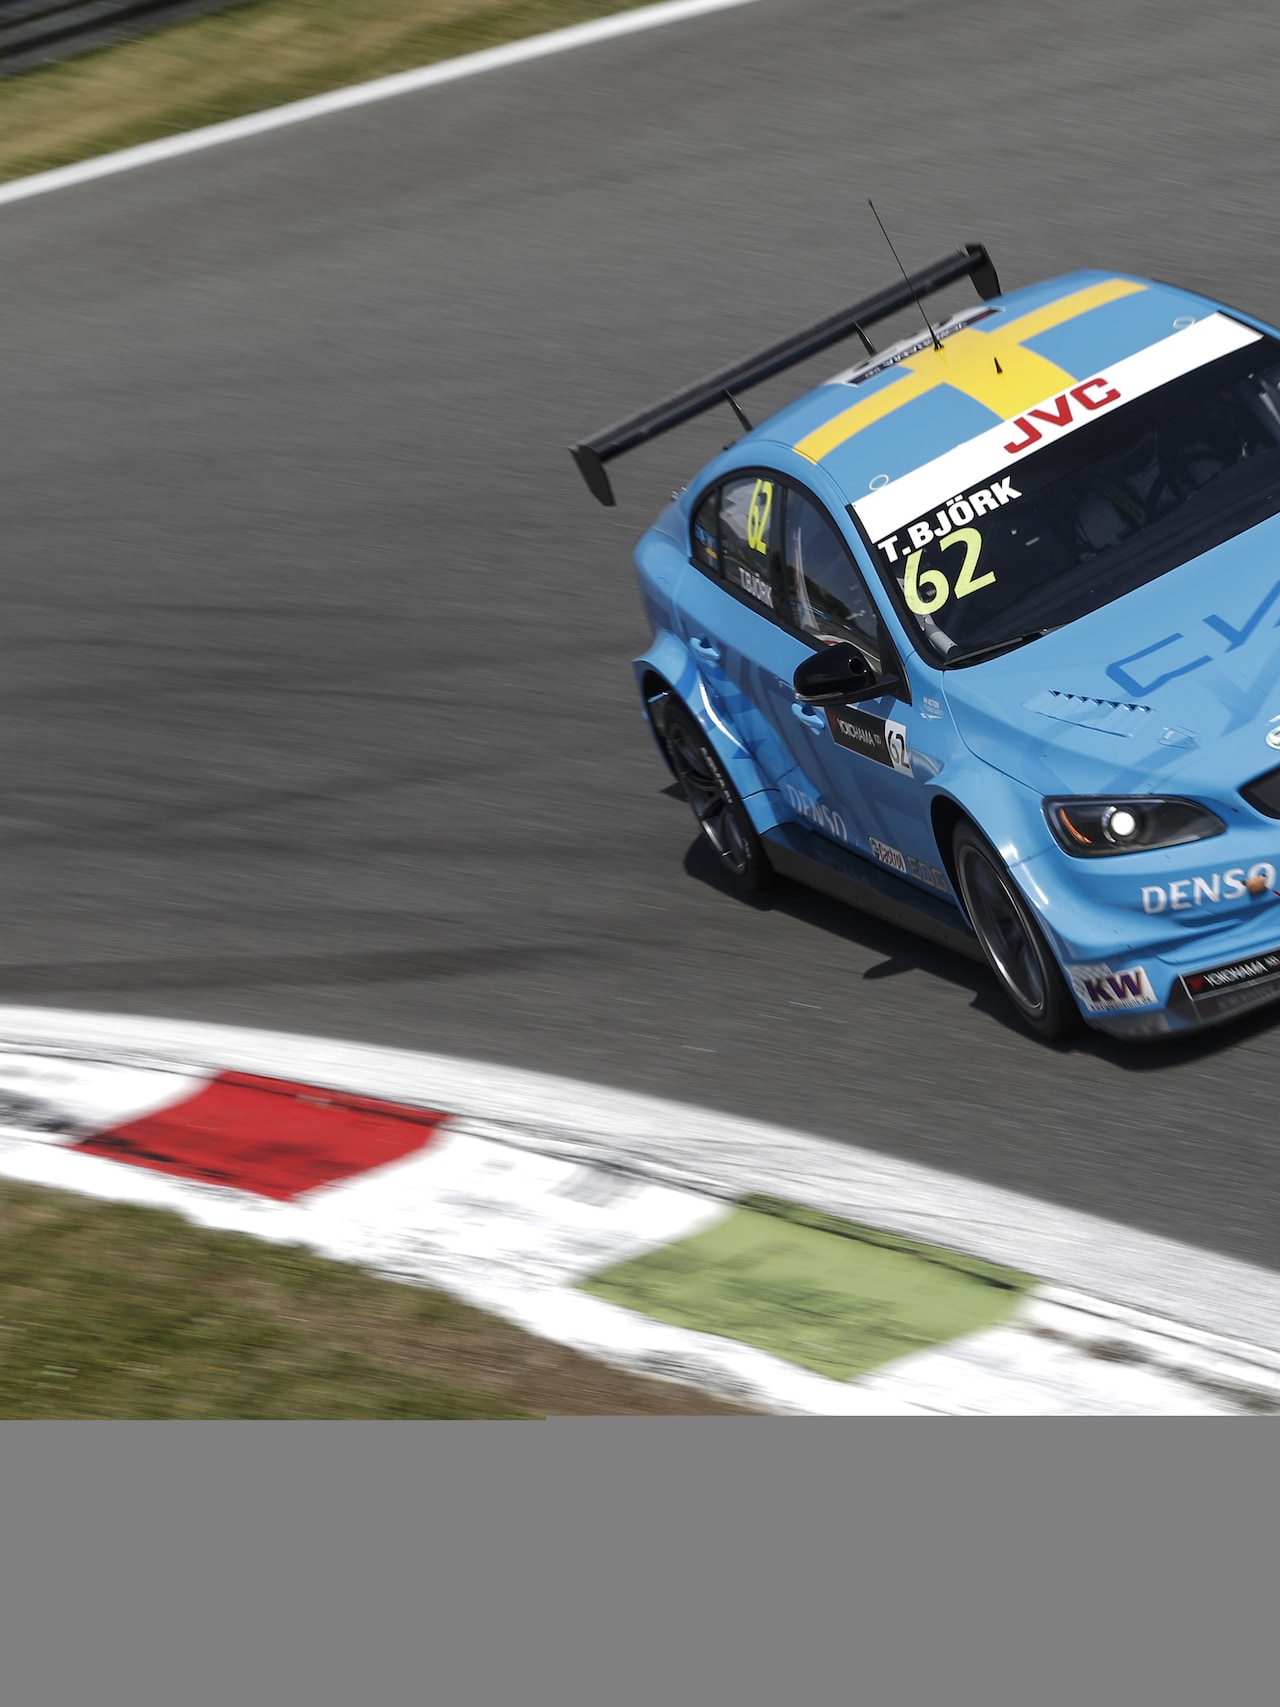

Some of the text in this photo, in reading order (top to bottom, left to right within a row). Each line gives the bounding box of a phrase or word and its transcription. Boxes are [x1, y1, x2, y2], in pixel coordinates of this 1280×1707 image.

[1003, 377, 1121, 454] JVC
[747, 478, 774, 555] 62
[877, 475, 1023, 563] T.BJÖRK
[903, 526, 997, 616] 62
[836, 718, 876, 747] YOKOHAMA
[887, 730, 910, 769] 62
[786, 783, 848, 841] DENSO
[906, 855, 953, 895] EDG
[1141, 861, 1278, 915] DENSO
[1083, 970, 1143, 1004] KW
[1202, 960, 1268, 988] YOKOHAMA
